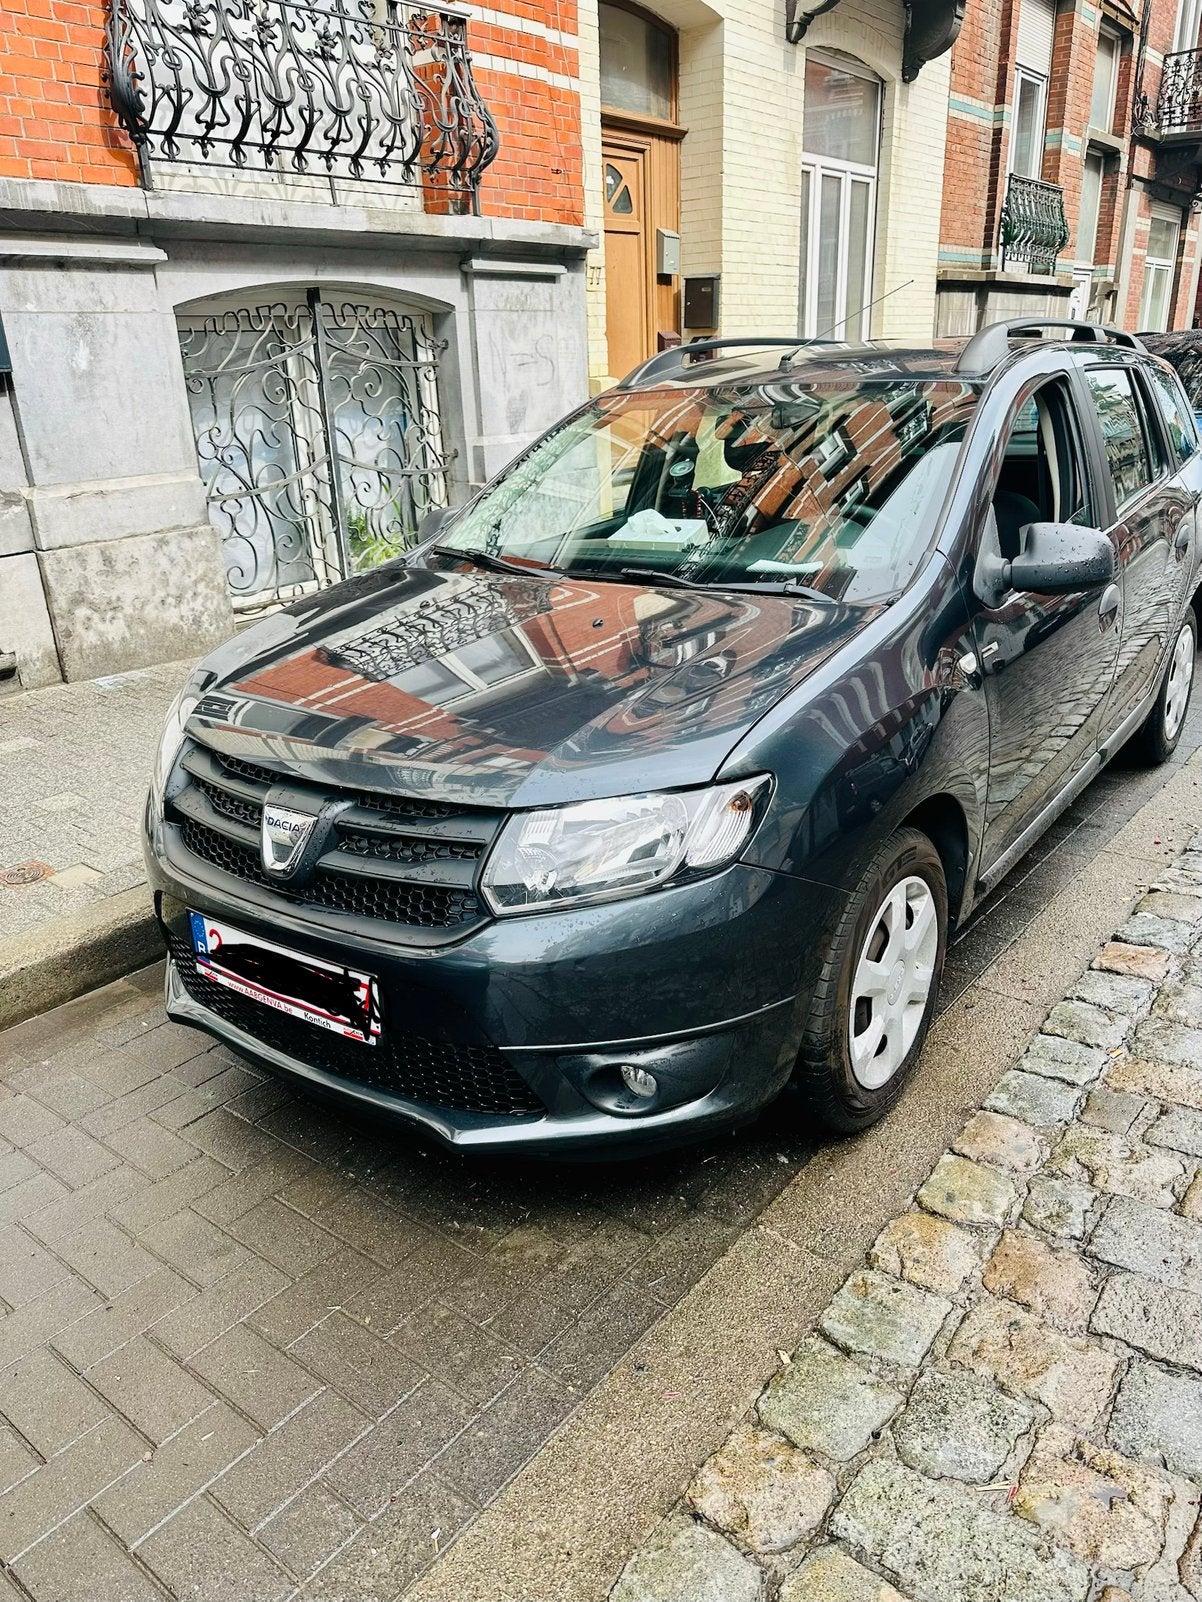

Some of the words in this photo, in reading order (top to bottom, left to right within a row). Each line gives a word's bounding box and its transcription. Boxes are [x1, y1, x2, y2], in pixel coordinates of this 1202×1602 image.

[590, 266, 601, 285] 77
[267, 816, 300, 832] DACIA
[304, 1012, 331, 1029] Kontich
